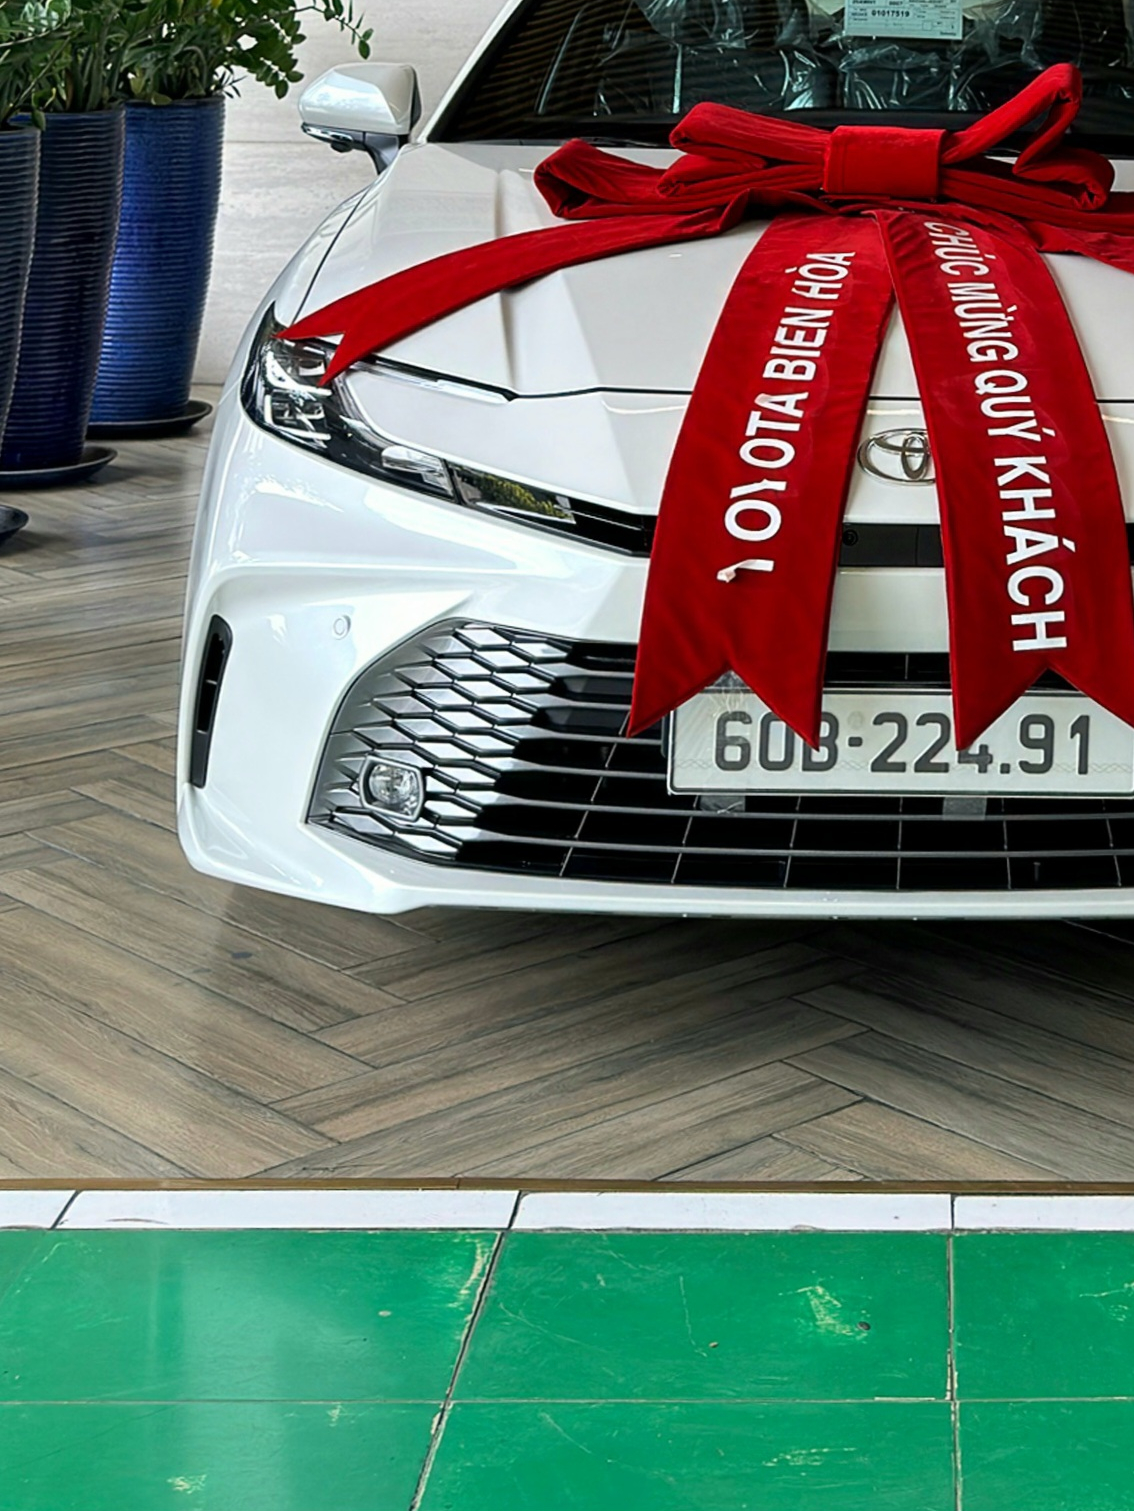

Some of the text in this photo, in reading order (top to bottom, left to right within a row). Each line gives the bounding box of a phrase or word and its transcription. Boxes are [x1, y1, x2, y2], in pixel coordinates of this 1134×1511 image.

[784, 251, 857, 301] HÒA
[923, 221, 1077, 653] CHÚC MỪNG QUÝ KHÁCH
